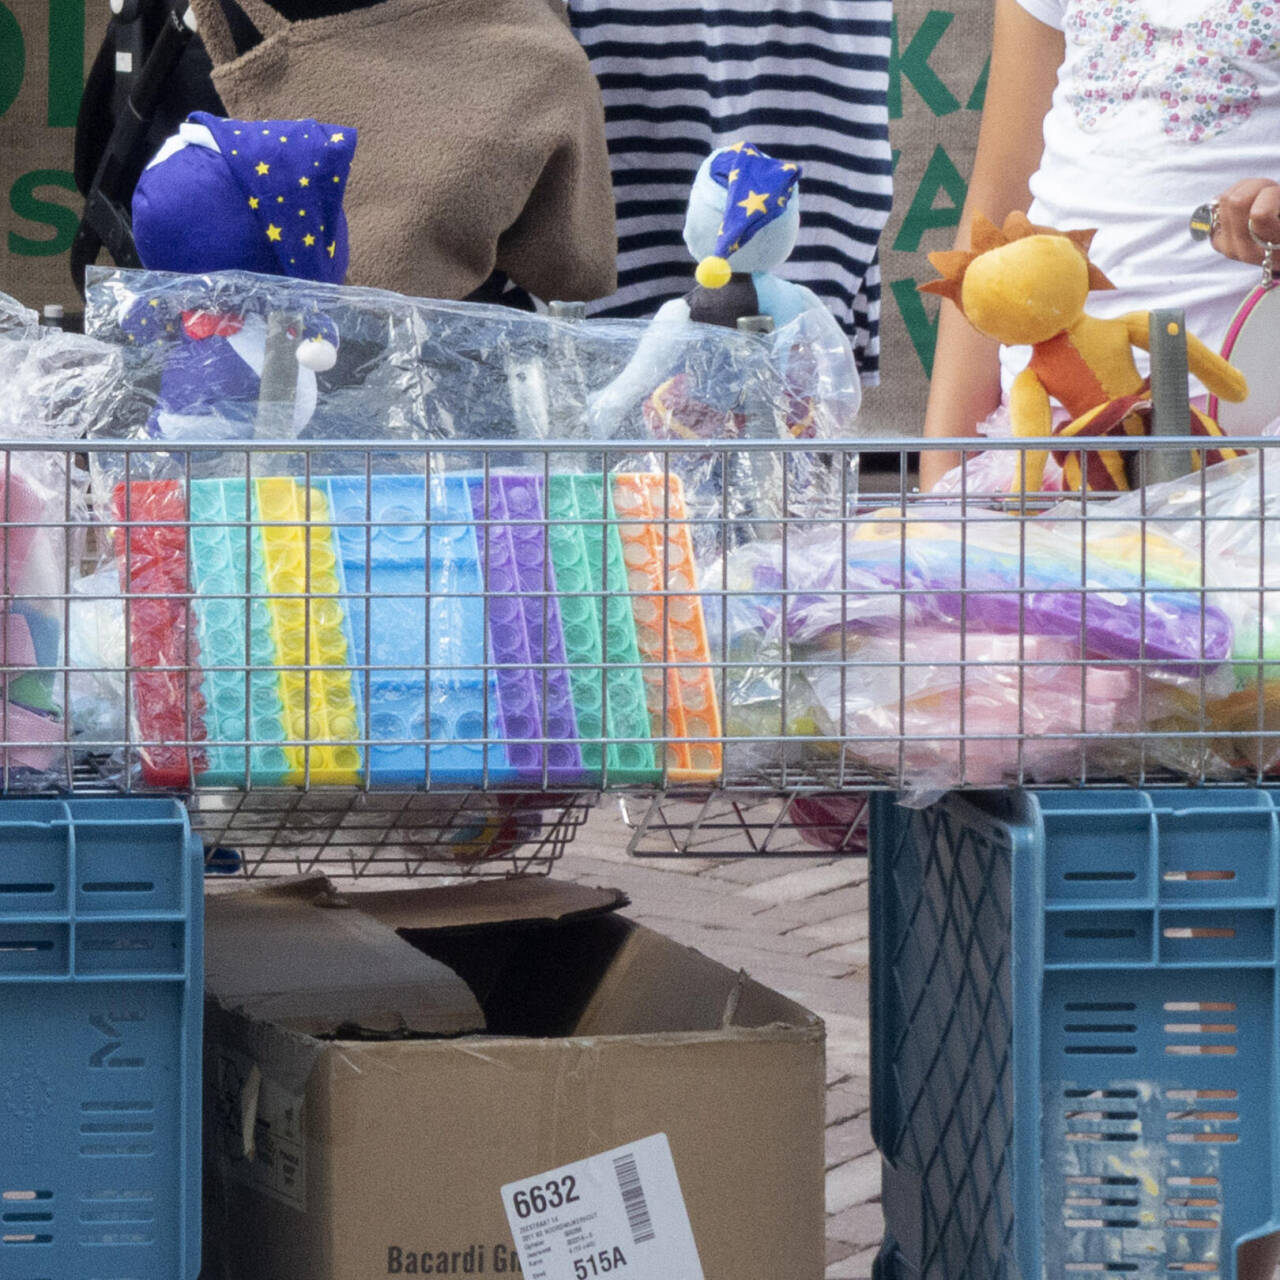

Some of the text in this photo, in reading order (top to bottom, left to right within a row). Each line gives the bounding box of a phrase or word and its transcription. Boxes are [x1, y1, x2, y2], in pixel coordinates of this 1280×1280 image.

[513, 1174, 581, 1219] 6632
[387, 1244, 486, 1274] Bacardi
[573, 1245, 628, 1280] 515A
